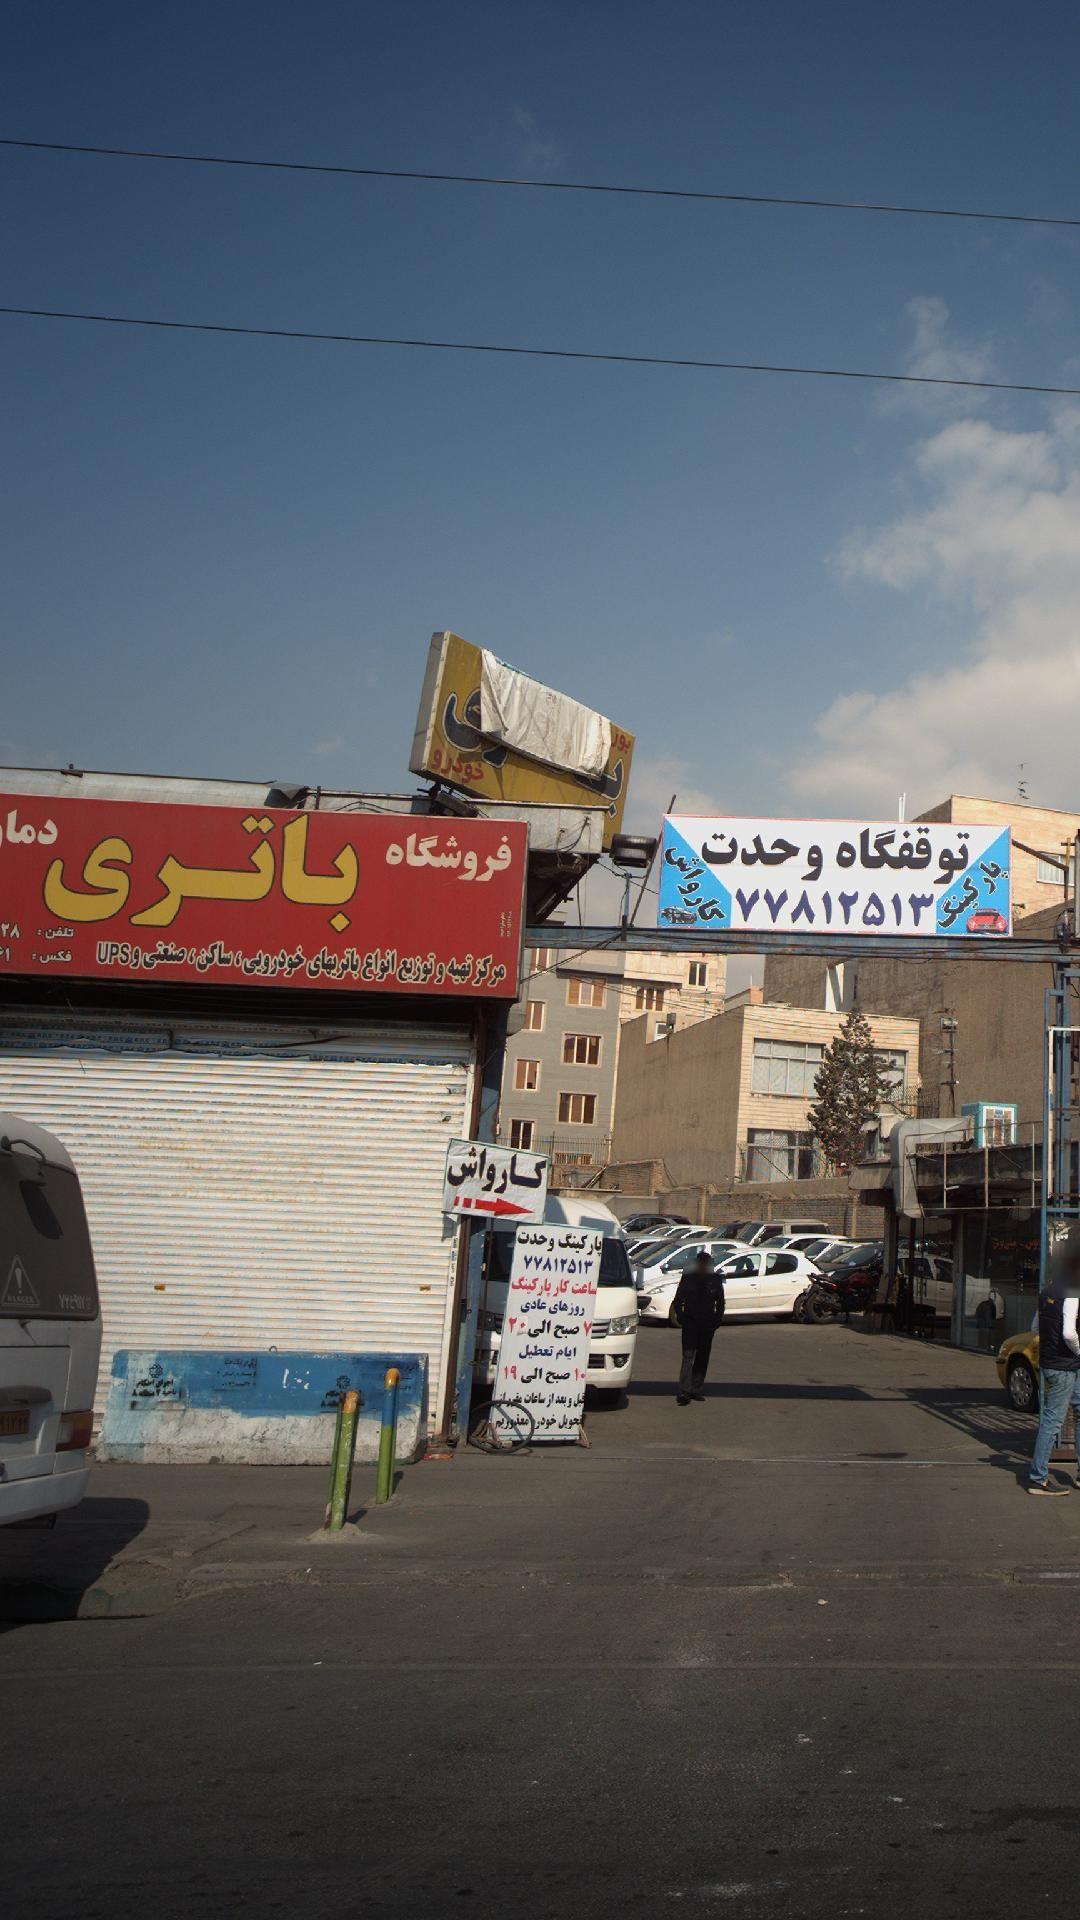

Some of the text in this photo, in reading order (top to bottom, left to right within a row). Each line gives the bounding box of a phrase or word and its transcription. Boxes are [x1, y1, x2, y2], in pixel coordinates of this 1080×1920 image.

[430, 750, 485, 784] خودرو
[0, 809, 58, 845] دما
[385, 834, 513, 881] فروشگاه
[701, 827, 970, 884] توقفگاه وحدت
[43, 813, 360, 933] باتری
[664, 847, 725, 922] کارواش
[734, 888, 935, 927] ۷۷۸۱۲۵۱۳
[97, 941, 131, 966] UPS
[130, 946, 141, 968] و
[142, 941, 186, 969] صنعتی
[306, 946, 361, 980] باتریهای
[361, 948, 397, 981] انواع
[397, 953, 435, 983] توزیع
[435, 963, 444, 984] و
[447, 954, 473, 983] تهیه
[472, 955, 506, 986] مرکز
[448, 1147, 546, 1193] کارواش
[517, 1232, 602, 1256] پارکینگ وحدت
[524, 1254, 593, 1274] ۷۷۸۱۲۵۱۳
[511, 1276, 597, 1296] ساعت کار پارکینگ
[520, 1298, 585, 1316] روزهای عادی
[528, 1319, 551, 1337] الی
[553, 1324, 580, 1338] صبح
[583, 1320, 592, 1336] ۷
[518, 1344, 577, 1360] ایام تعطیل
[505, 1365, 586, 1384] ۱۰ صبح الی ۱۹
[546, 1393, 554, 1407] از
[555, 1395, 567, 1406] بعد
[533, 1414, 557, 1430] خودر
